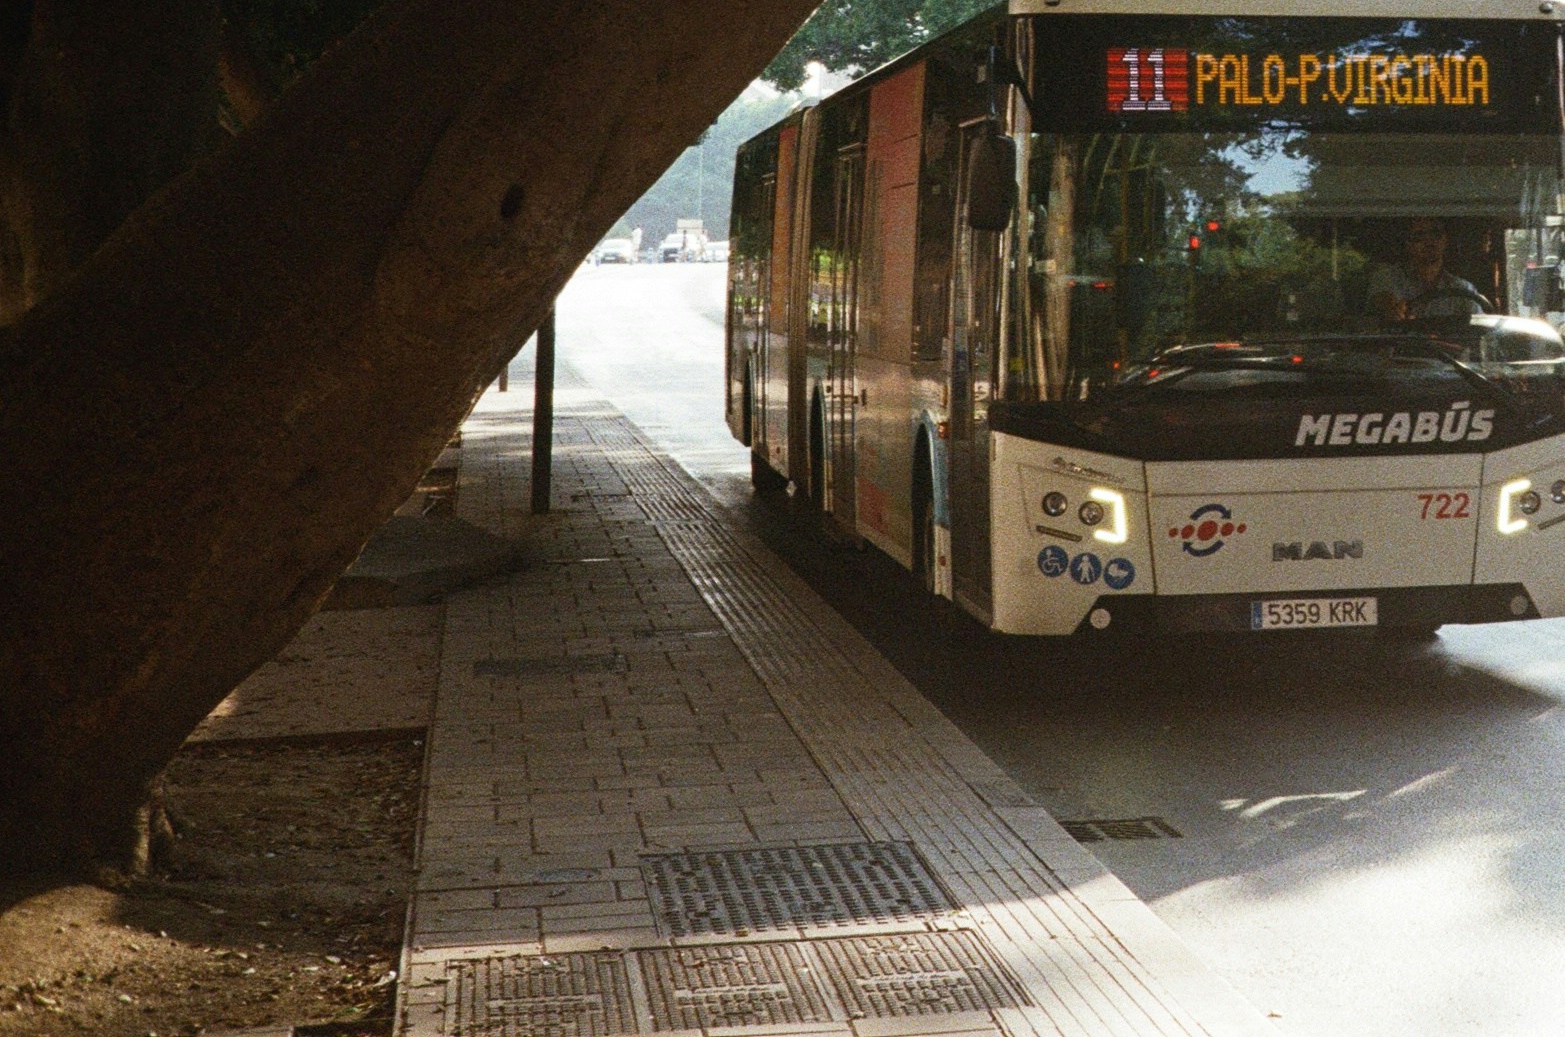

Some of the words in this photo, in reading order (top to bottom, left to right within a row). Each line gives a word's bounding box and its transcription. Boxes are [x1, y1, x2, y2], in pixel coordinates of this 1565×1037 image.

[1121, 48, 1171, 111] 11
[1196, 54, 1489, 105] PALO-P.VIRGINIA
[1295, 400, 1495, 446] MEGABÚS
[1417, 492, 1470, 520] 722
[1272, 540, 1364, 562] MAN
[1268, 603, 1321, 626] 5359
[1329, 601, 1368, 622] KRK
